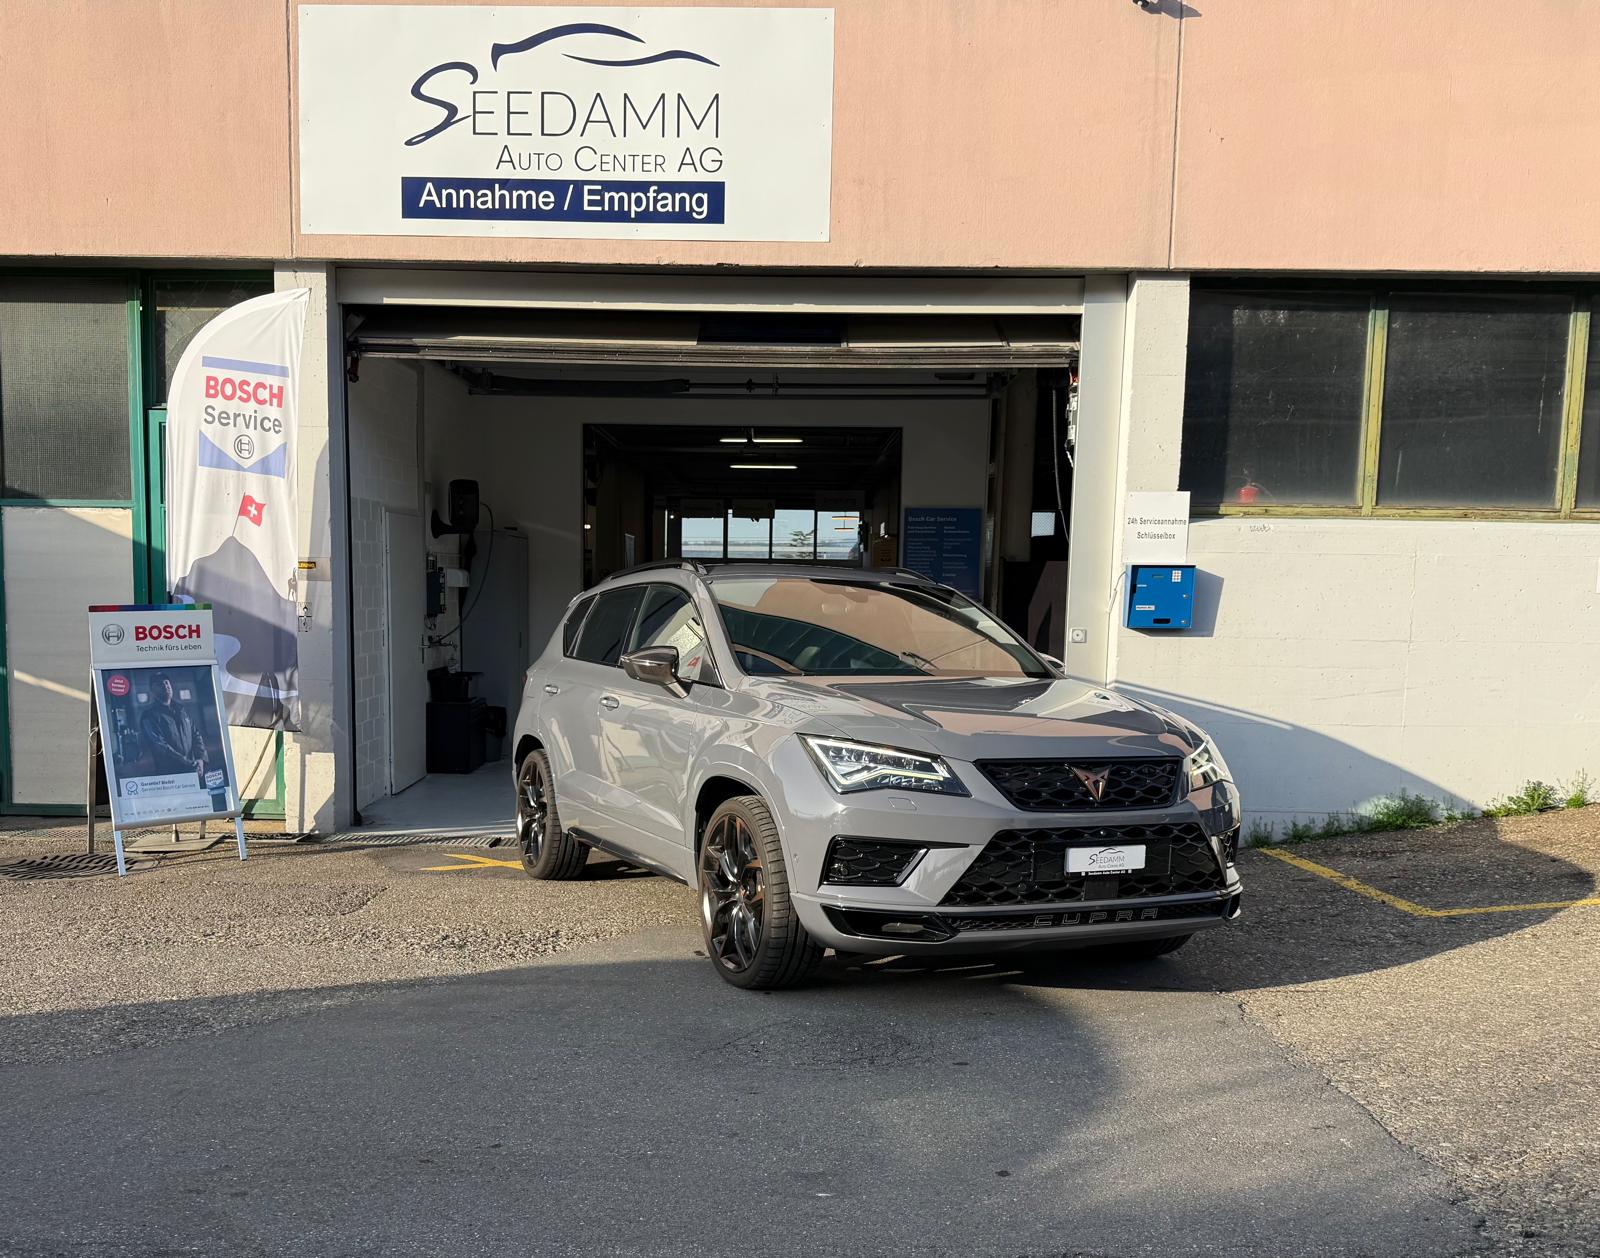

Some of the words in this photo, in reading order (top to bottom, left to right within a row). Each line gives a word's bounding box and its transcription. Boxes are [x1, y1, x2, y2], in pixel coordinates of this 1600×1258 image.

[404, 61, 720, 147] SEEDAMM
[677, 146, 723, 174] AG
[418, 182, 555, 211] Annahme
[563, 184, 574, 211] /
[582, 184, 709, 218] Empfang
[205, 375, 284, 408] BOSCH
[203, 404, 283, 434] Service
[1127, 517, 1138, 525] 24h
[1139, 517, 1187, 526] Serviceannahme
[1136, 531, 1176, 540] Schlüsselbox
[134, 624, 201, 641] BOSCH
[136, 644, 164, 653] Technik
[164, 643, 180, 652] fürs
[180, 643, 202, 651] Leben
[1088, 853, 1125, 866] SEEDAMM
[1033, 907, 1159, 928] CUPRA
